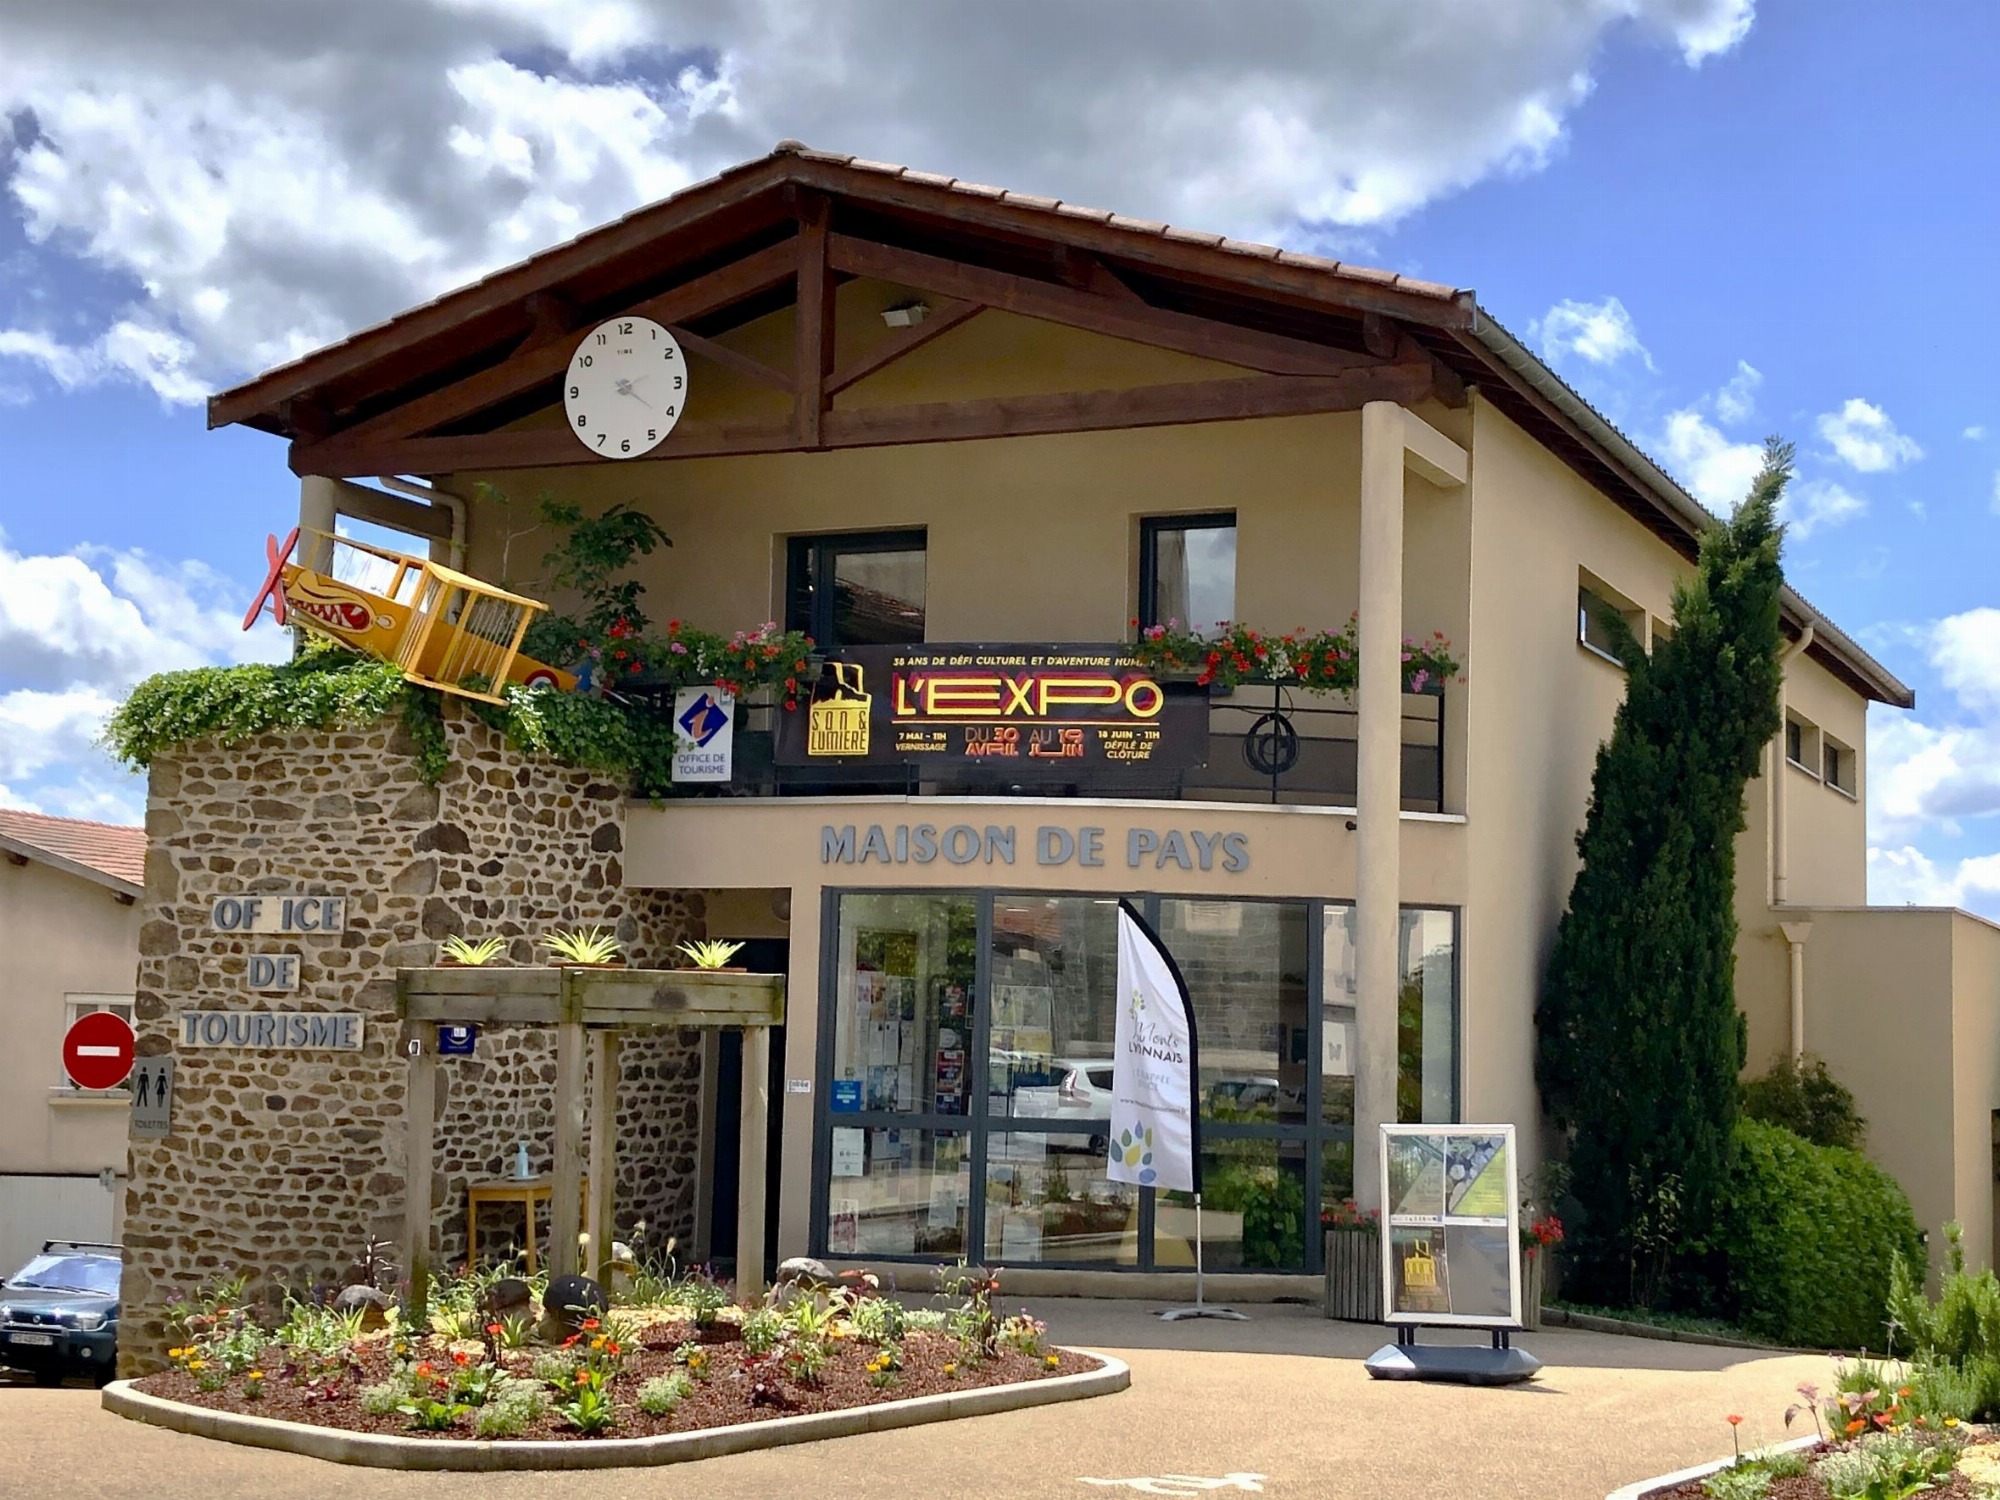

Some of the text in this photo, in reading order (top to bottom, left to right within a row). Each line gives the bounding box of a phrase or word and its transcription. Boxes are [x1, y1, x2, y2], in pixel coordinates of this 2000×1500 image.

[618, 323, 633, 335] 12
[651, 329, 656, 340] 1
[597, 334, 606, 345] 11
[664, 348, 674, 360] 2
[579, 356, 593, 368] 10
[673, 376, 682, 389] 3
[570, 386, 579, 399] 9
[666, 406, 675, 417] 4
[577, 415, 587, 427] 8
[597, 434, 607, 447] 7
[647, 429, 656, 441] 5
[621, 440, 630, 452] 6
[907, 657, 928, 666] ANS
[932, 657, 946, 666] DE
[976, 656, 1027, 666] CULTUREL
[1031, 657, 1043, 666] ET
[1047, 657, 1111, 666] D'AVENTURE
[898, 679, 1164, 717] L'EXPO
[859, 711, 867, 730] &
[811, 731, 866, 750] LUMIERE
[965, 727, 1019, 742] DU 30
[1029, 729, 1084, 744] AU 19
[1111, 731, 1132, 739] JUIN
[1145, 731, 1160, 739] 11H
[895, 743, 947, 751] VERNISSAGE
[965, 742, 1019, 756] AVRIL
[1029, 743, 1083, 756] JUIN
[1140, 741, 1153, 750] DE
[678, 754, 725, 763] OFFICE DE
[680, 765, 724, 774] TOURISME
[821, 824, 1249, 872] MAISON DE PAYS
[250, 957, 295, 989] DE
[183, 1013, 359, 1049] TOURISME
[1128, 1041, 1184, 1064] LYNNAIS
